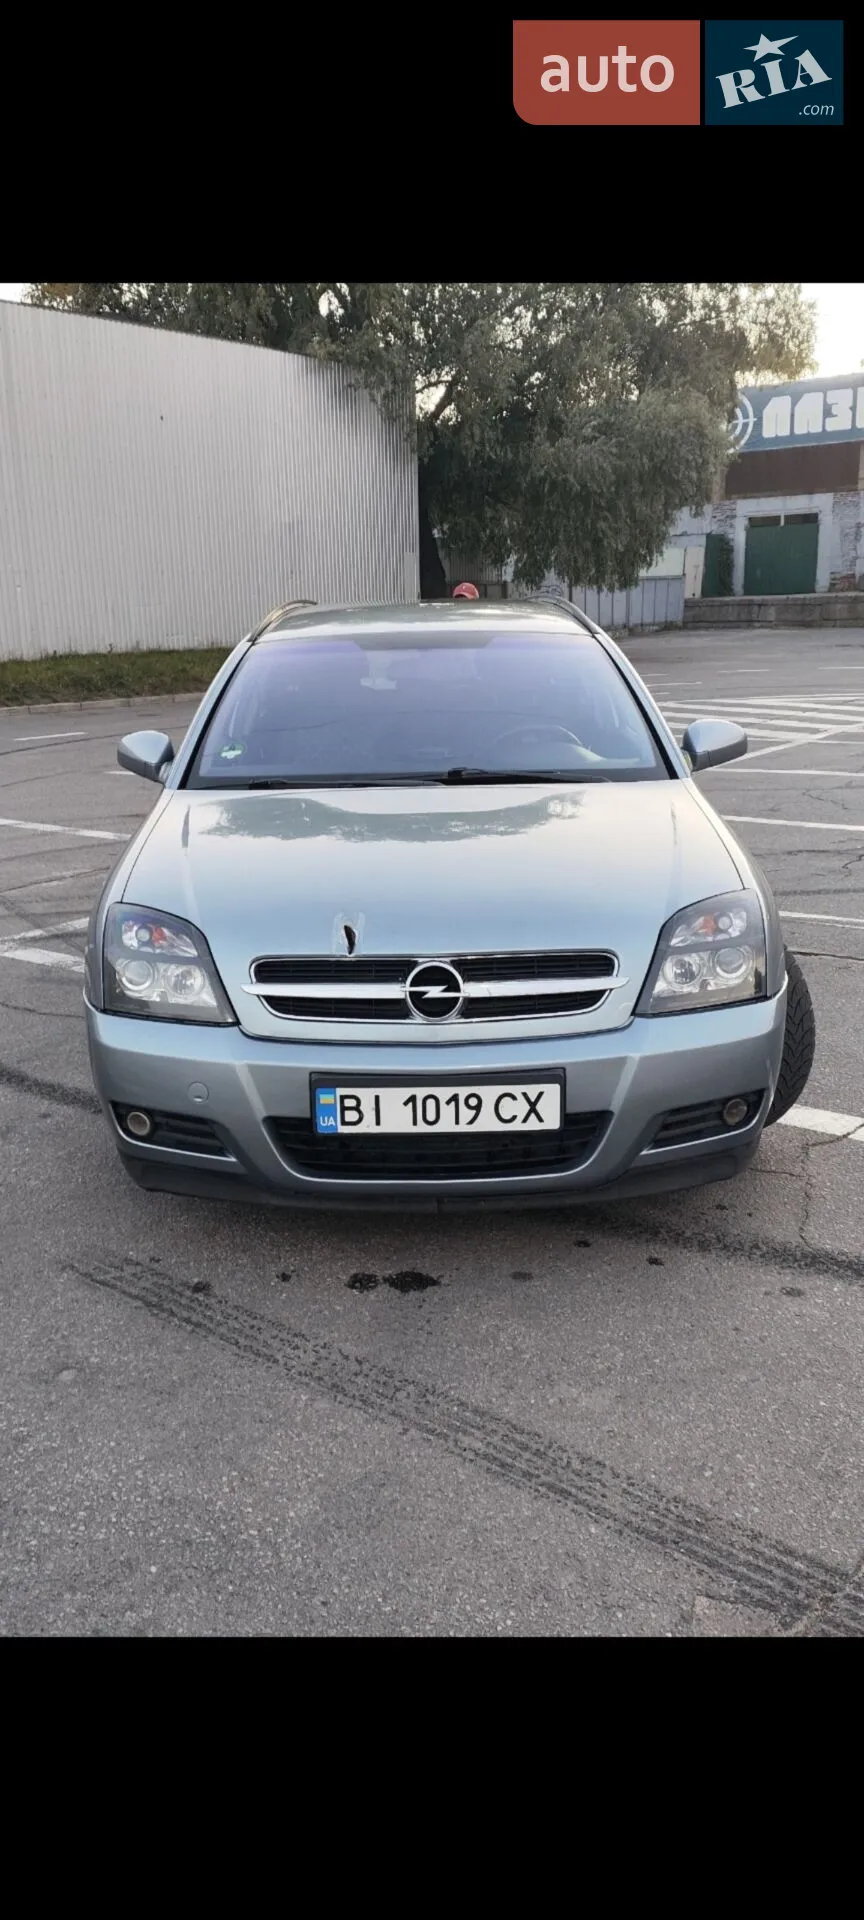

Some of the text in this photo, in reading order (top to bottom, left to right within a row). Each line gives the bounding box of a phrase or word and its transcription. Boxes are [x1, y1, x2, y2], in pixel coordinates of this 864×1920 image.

[339, 1091, 545, 1127] BI 1019 CX
[319, 1117, 336, 1127] UA
